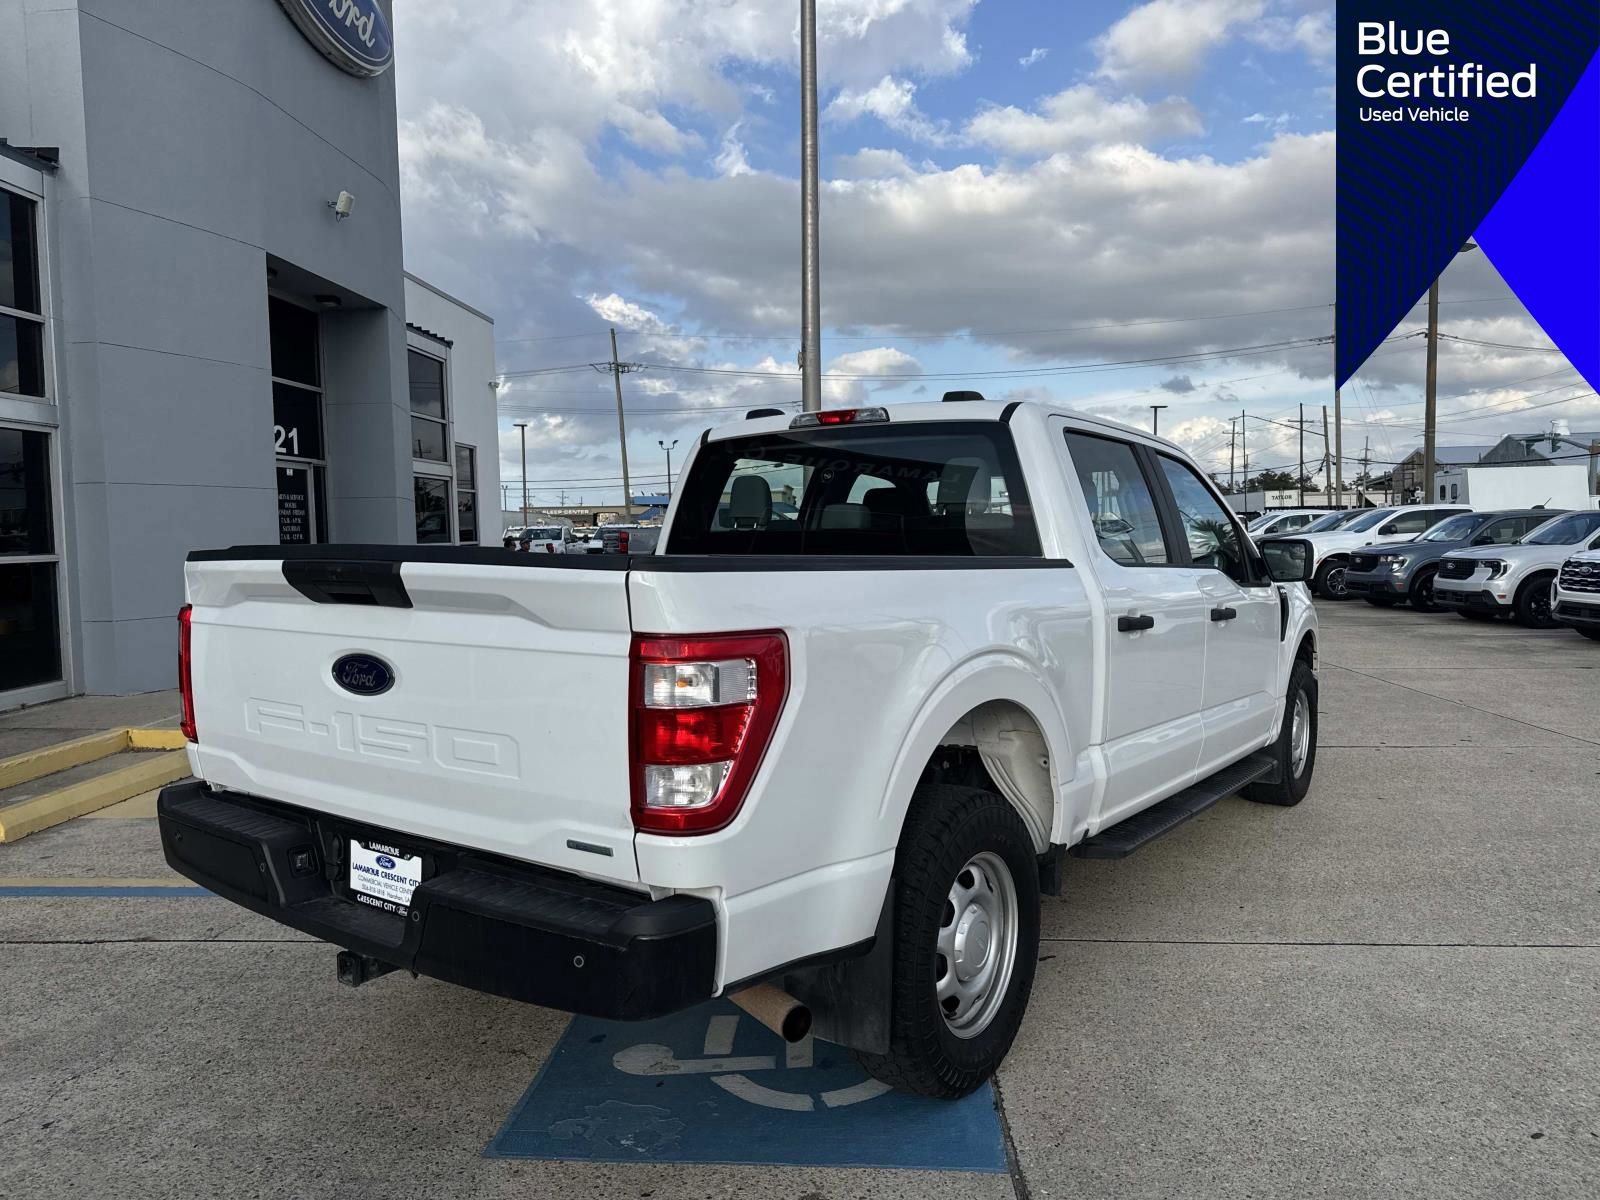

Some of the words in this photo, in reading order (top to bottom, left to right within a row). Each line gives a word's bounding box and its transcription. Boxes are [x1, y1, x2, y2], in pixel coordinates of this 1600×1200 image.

[328, 0, 376, 48] ord
[342, 661, 377, 687] Ford
[244, 697, 521, 780] F-150
[368, 841, 400, 856] LAMARQUE
[352, 862, 380, 877] LAMARQUE
[380, 871, 408, 885] CRESCENT
[379, 856, 393, 868] Ford
[356, 894, 383, 908] CRESCENT
[384, 902, 397, 913] CITY
